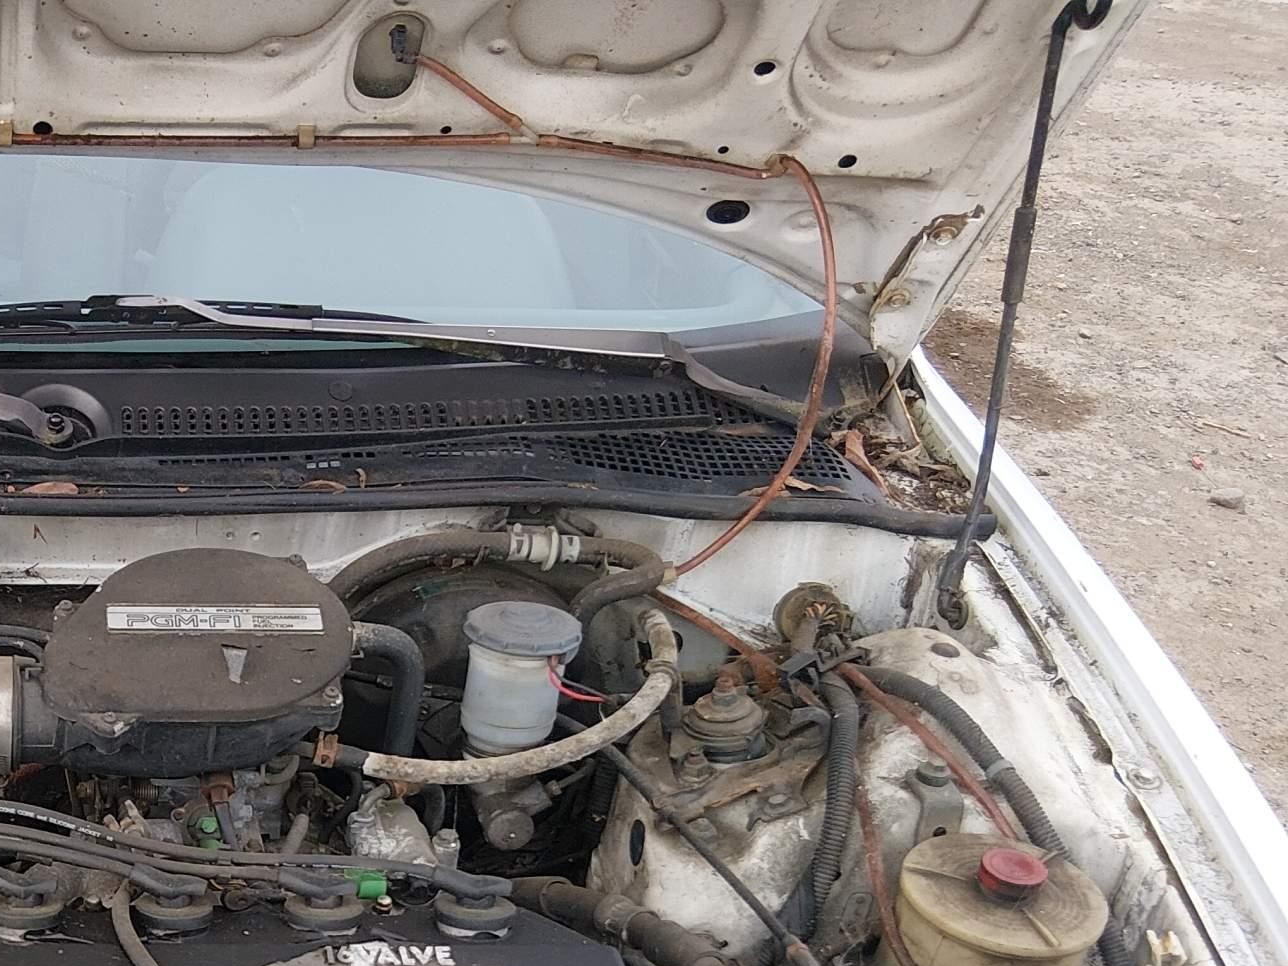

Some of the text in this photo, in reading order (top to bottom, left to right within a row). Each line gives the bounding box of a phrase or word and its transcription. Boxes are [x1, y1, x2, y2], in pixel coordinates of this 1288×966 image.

[126, 614, 242, 628] PGM-FI
[78, 825, 102, 838] JACKET
[363, 945, 456, 966] VALVE
